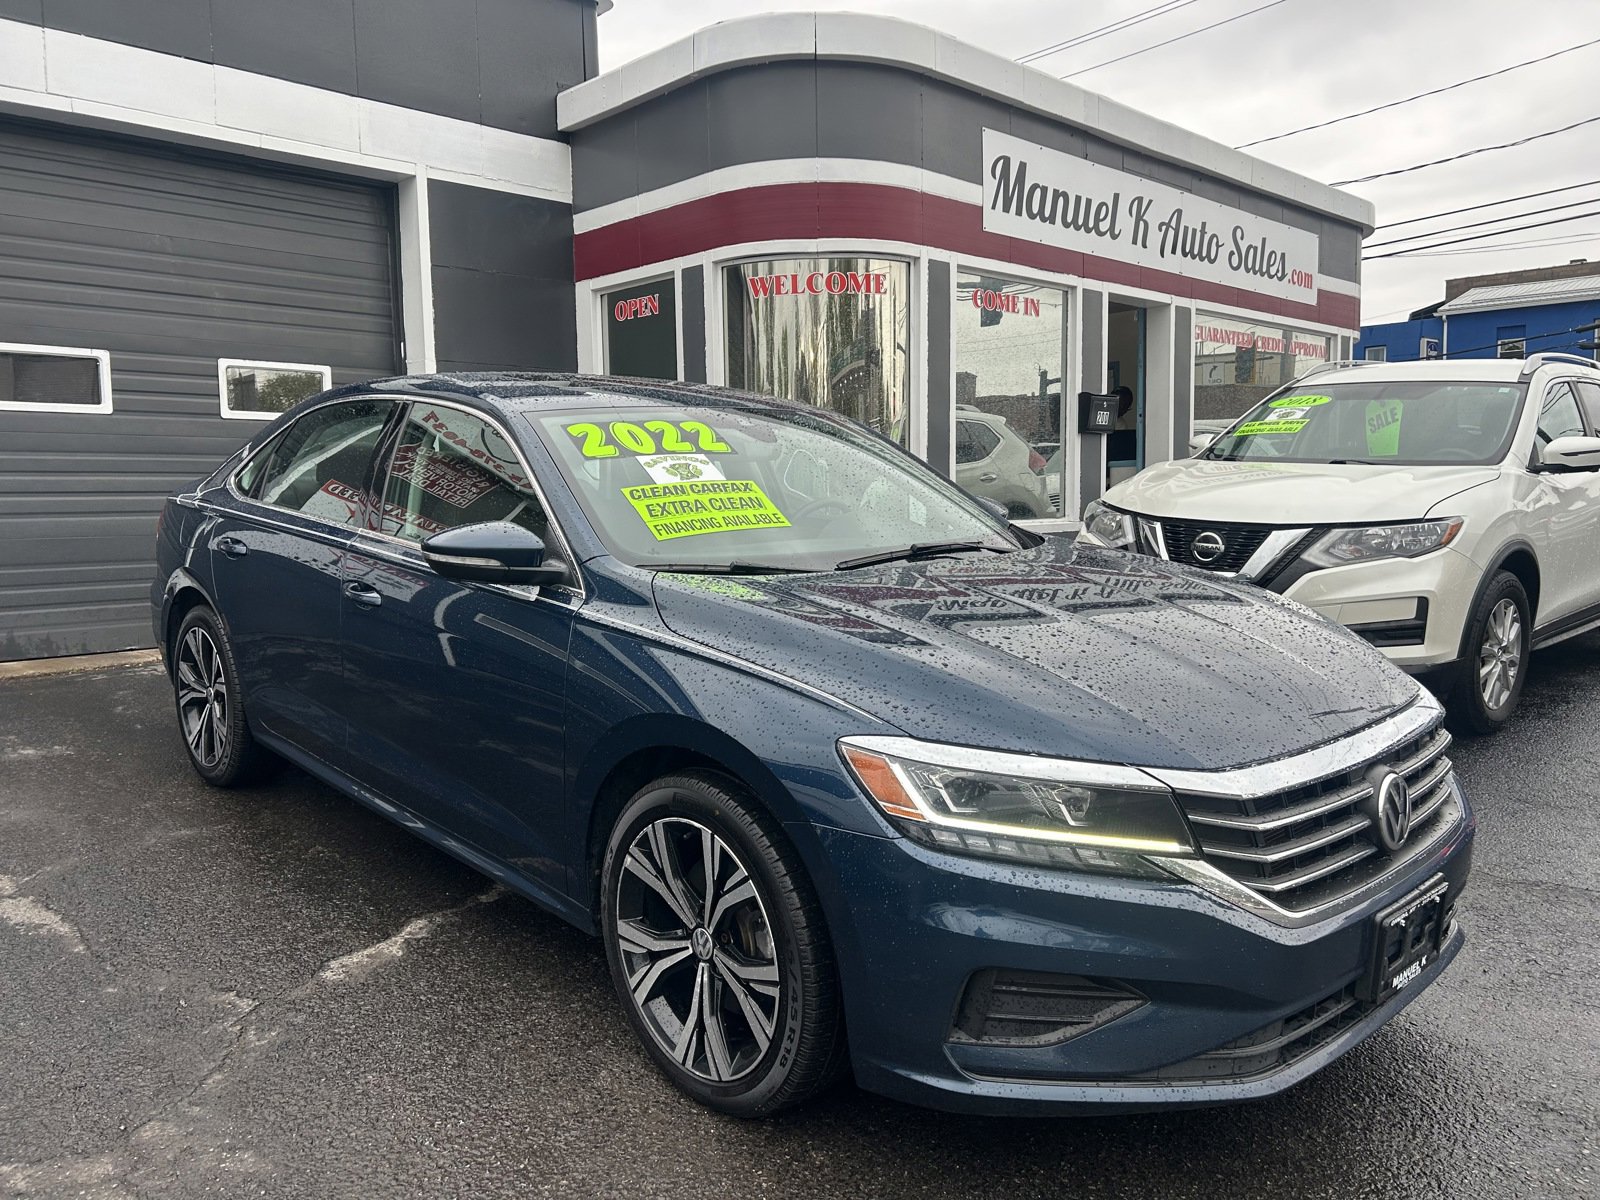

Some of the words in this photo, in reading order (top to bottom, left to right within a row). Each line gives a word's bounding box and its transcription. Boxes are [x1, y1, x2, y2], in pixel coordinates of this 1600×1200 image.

[990, 154, 1121, 241] Manuel
[1128, 195, 1154, 249] K
[1158, 208, 1225, 264] Auto
[748, 271, 888, 299] WELCOME
[614, 293, 660, 322] OPEN
[972, 288, 1020, 315] COME
[1023, 298, 1040, 317] IN
[1195, 325, 1254, 348] GUARANTEED
[1256, 335, 1287, 353] CREDIT
[1289, 340, 1329, 359] APPROVAL
[1368, 406, 1399, 433] SALE
[566, 420, 732, 457] 2022
[643, 455, 710, 468] SAVINGS
[629, 484, 689, 501] CLEAN
[689, 481, 753, 496] CARFAX
[645, 499, 707, 518] EXTRA
[708, 496, 764, 513] CLEAN
[653, 516, 722, 537] FINANCING
[722, 512, 785, 527] AVAILABLE
[1193, 543, 1221, 551] NISSAN
[1391, 960, 1420, 988] MANUEL
[1421, 955, 1427, 967] K
